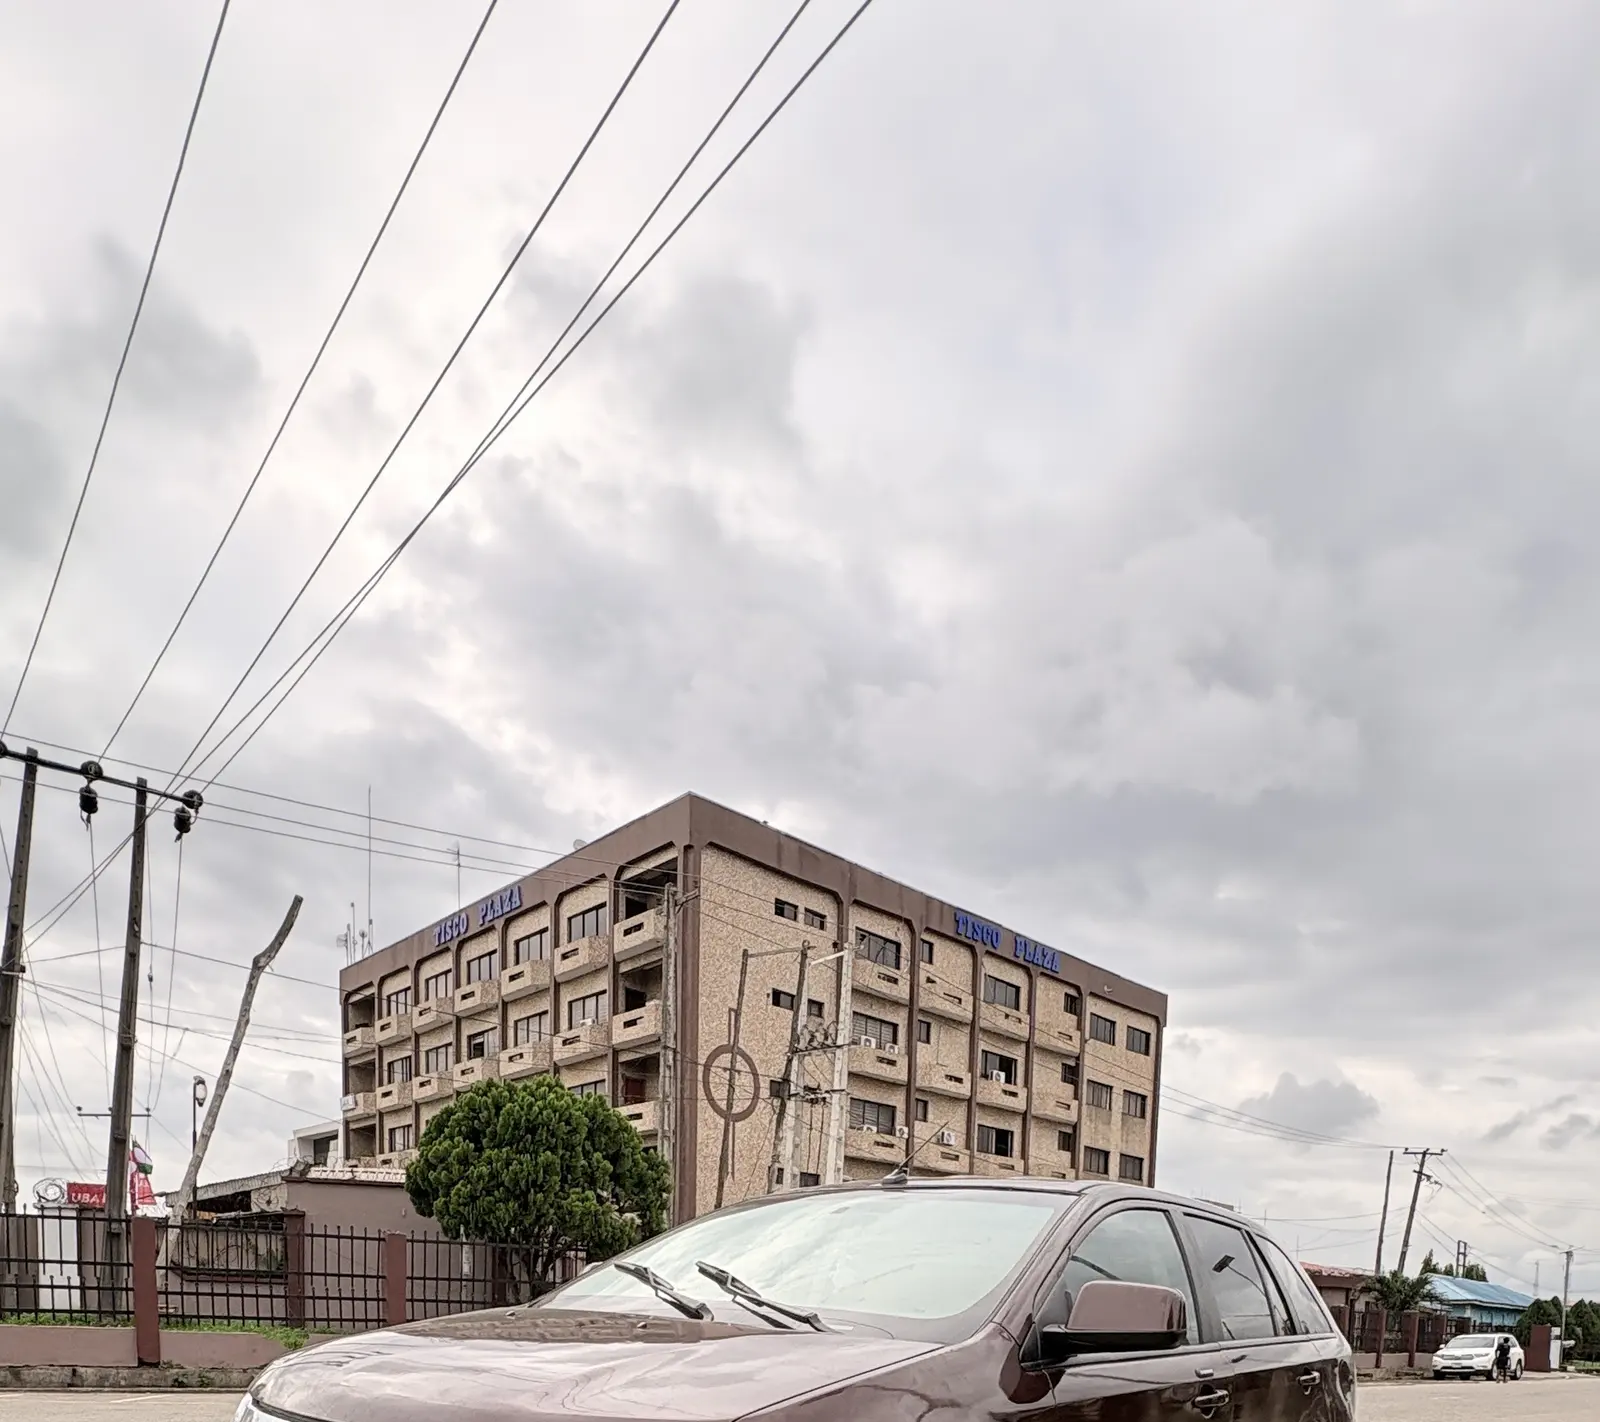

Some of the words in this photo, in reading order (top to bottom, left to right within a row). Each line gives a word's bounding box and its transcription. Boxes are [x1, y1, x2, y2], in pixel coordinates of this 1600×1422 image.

[433, 911, 469, 948] TISCO
[478, 885, 524, 927] PLAZA
[954, 909, 1003, 950] TISCO
[1013, 934, 1061, 974] PLAZA
[71, 1192, 100, 1205] UBA
